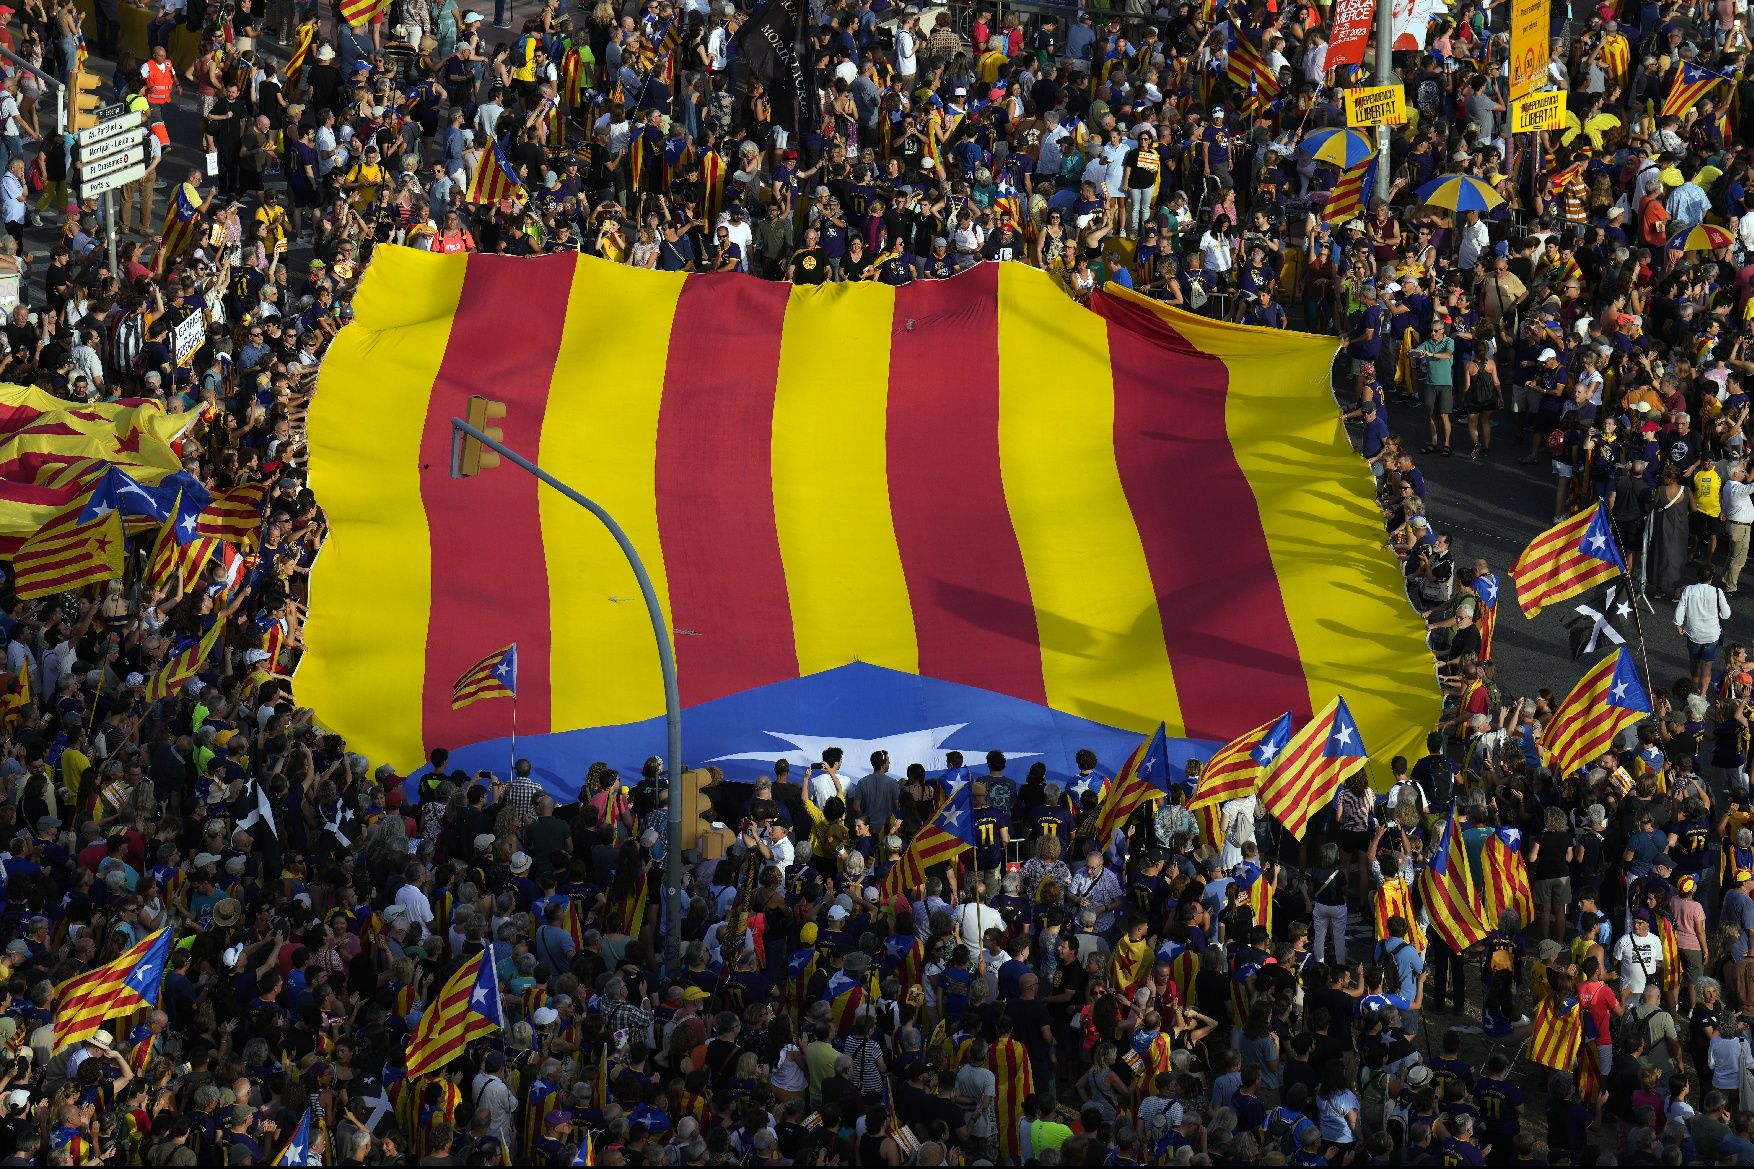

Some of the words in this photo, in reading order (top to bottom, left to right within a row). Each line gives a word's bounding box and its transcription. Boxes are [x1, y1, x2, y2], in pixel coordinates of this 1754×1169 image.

[1350, 27, 1367, 36] 2023
[1355, 101, 1396, 123] LLIBERTAT
[1520, 105, 1559, 128] LLIBERTAT
[978, 823, 995, 846] 11
[1484, 1096, 1502, 1120] 11
